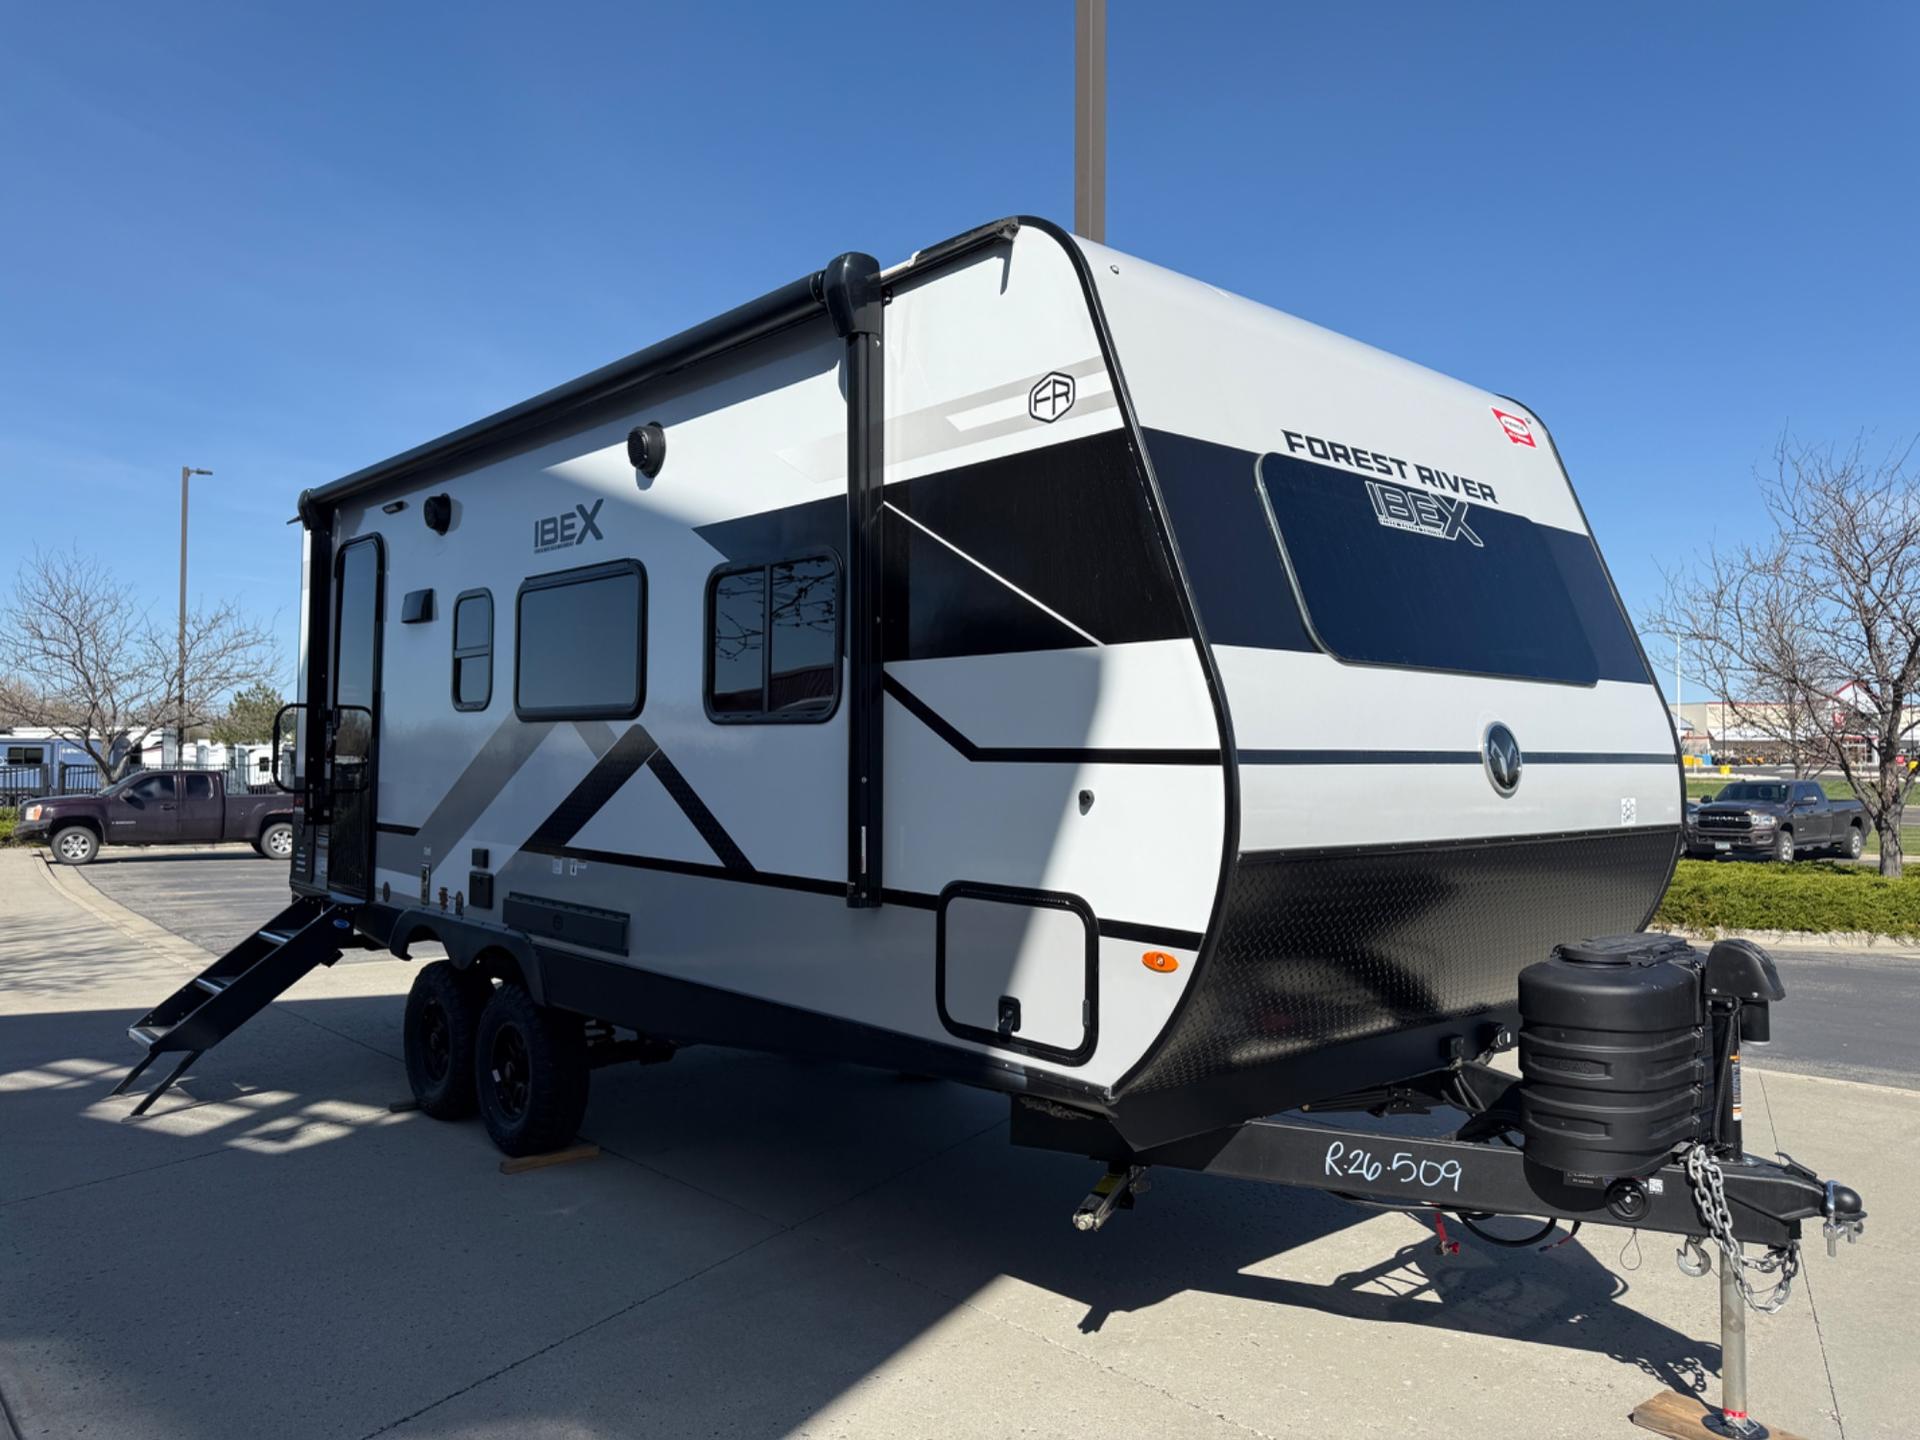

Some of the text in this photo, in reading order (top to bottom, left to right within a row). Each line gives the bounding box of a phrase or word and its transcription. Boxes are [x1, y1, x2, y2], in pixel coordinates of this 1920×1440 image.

[1281, 429, 1499, 504] FOREST RIVER
[534, 498, 604, 548] IBEX
[1364, 480, 1484, 547] IBEX
